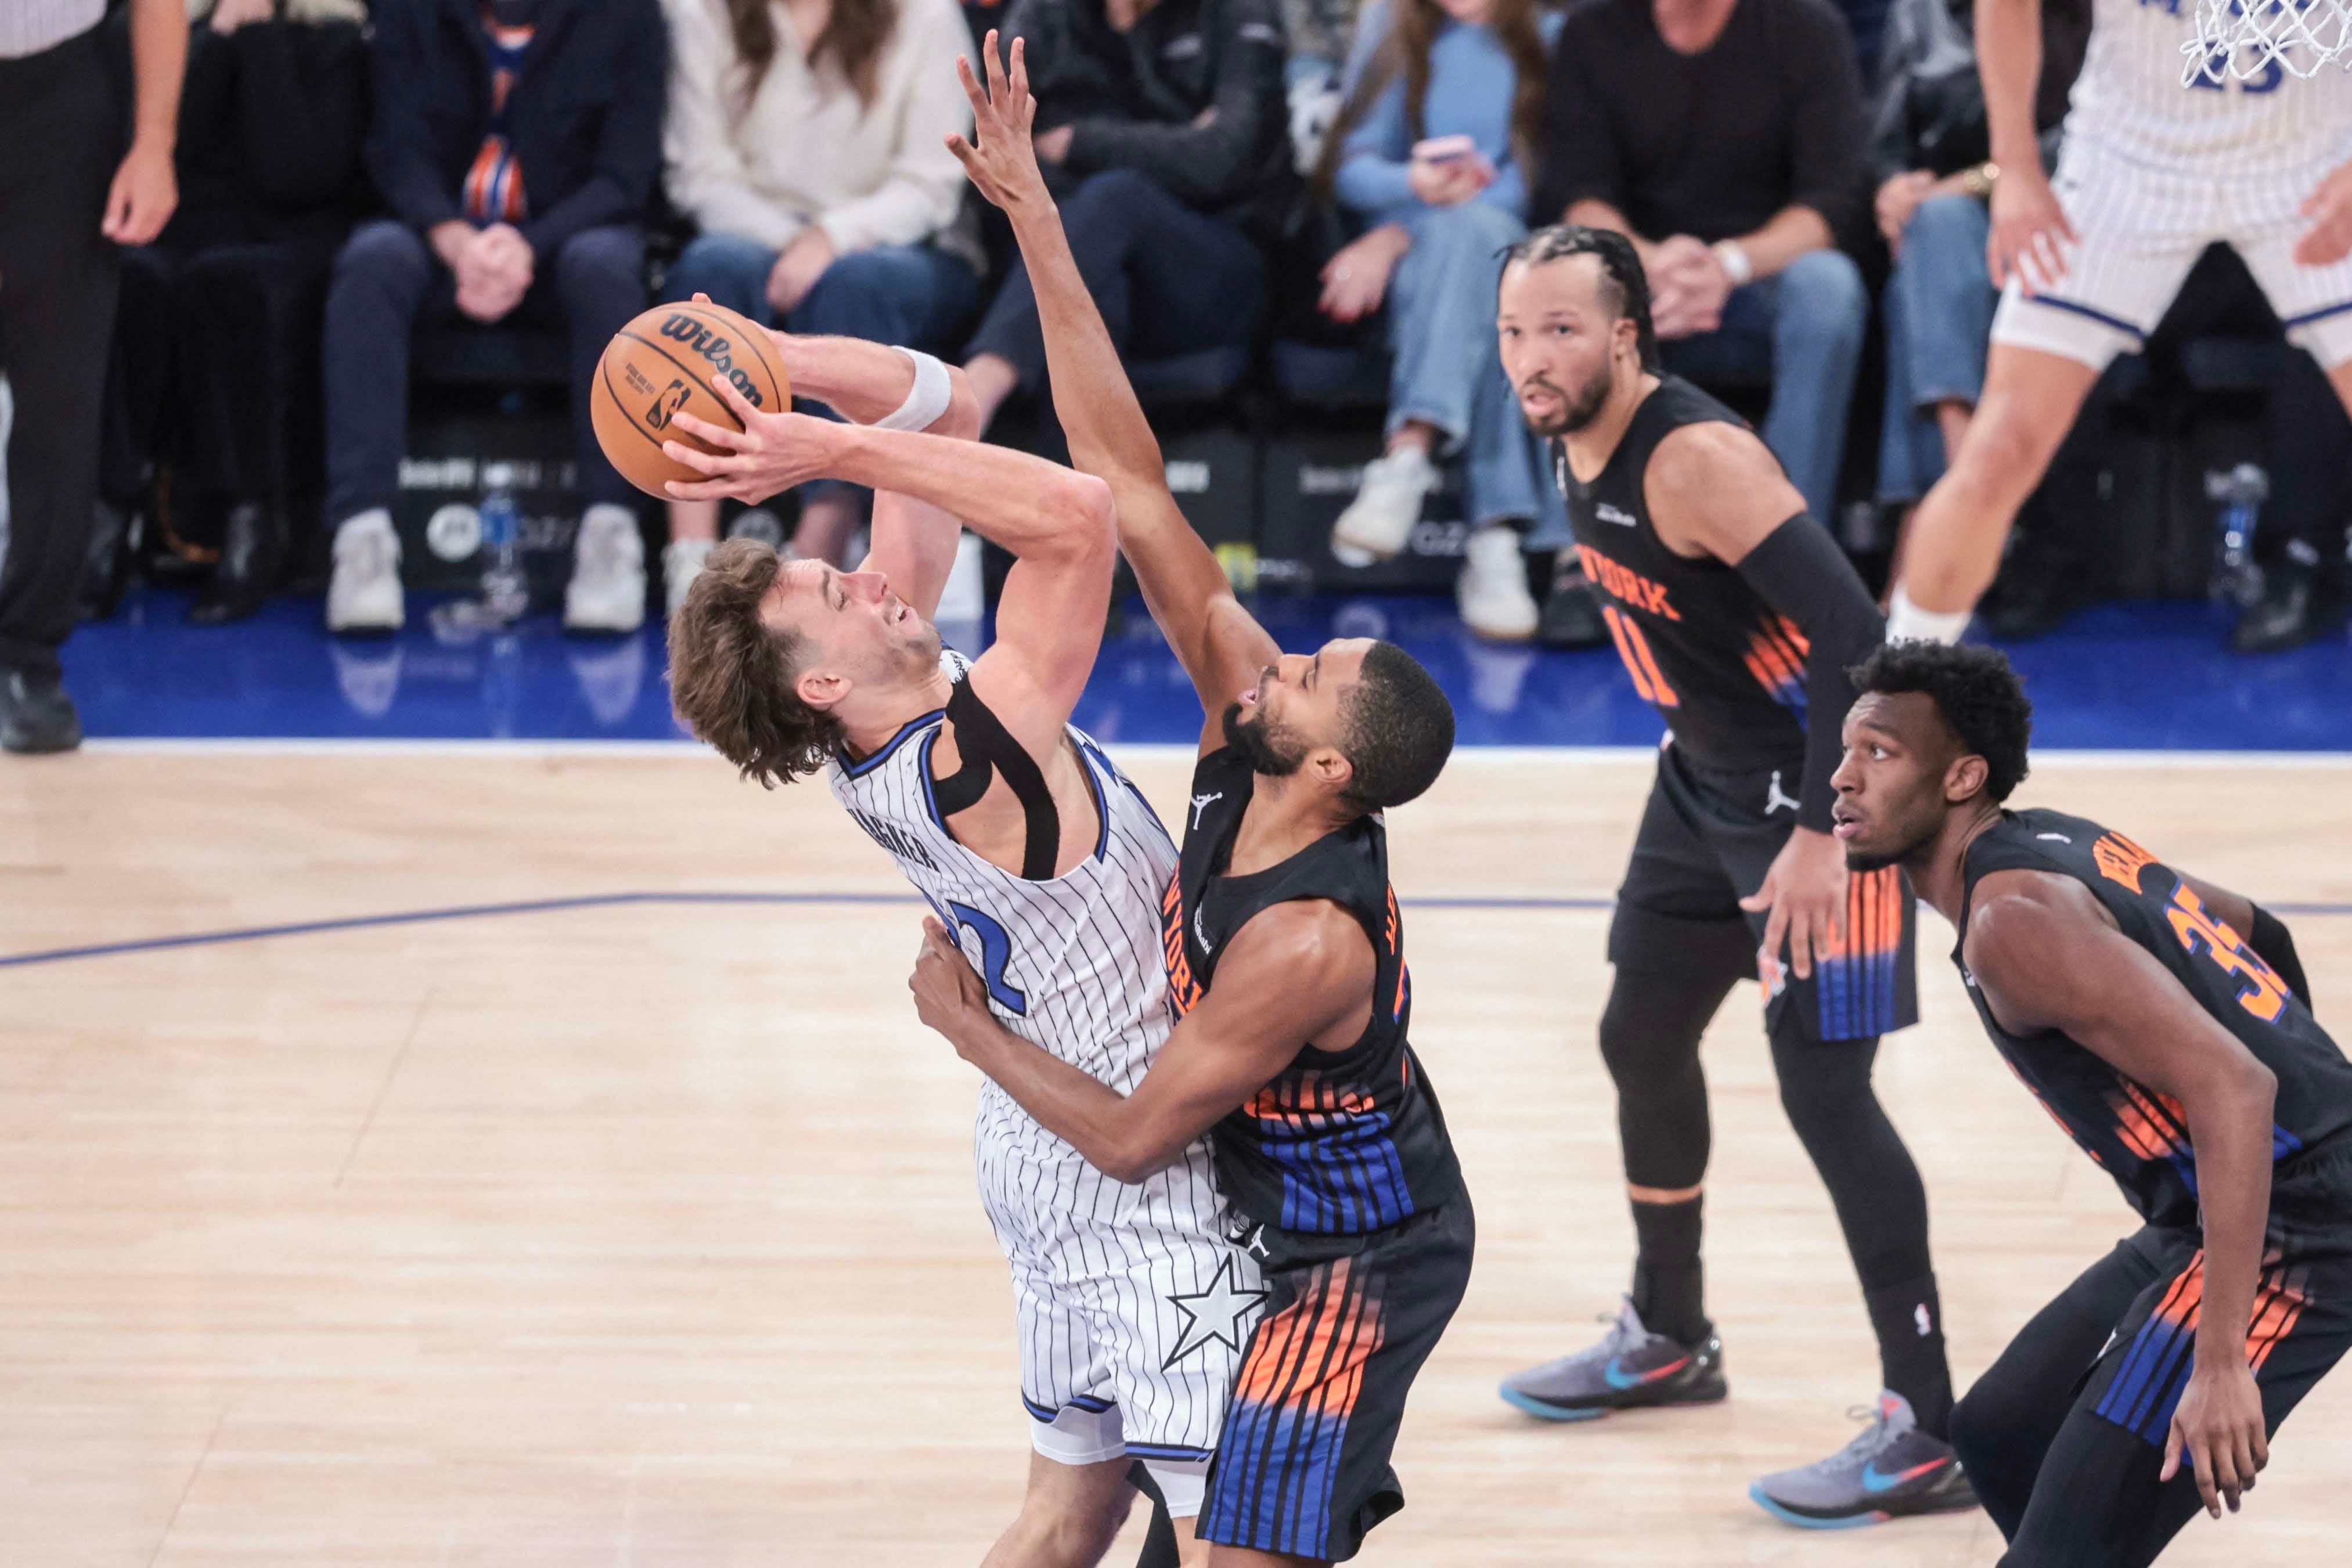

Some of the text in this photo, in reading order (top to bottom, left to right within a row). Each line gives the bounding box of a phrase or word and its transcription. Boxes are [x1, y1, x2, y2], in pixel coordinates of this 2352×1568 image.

[660, 313, 763, 408] Wilson
[1601, 604, 1680, 707] 11
[923, 891, 1027, 1018] 2
[2164, 877, 2292, 1025] 35
